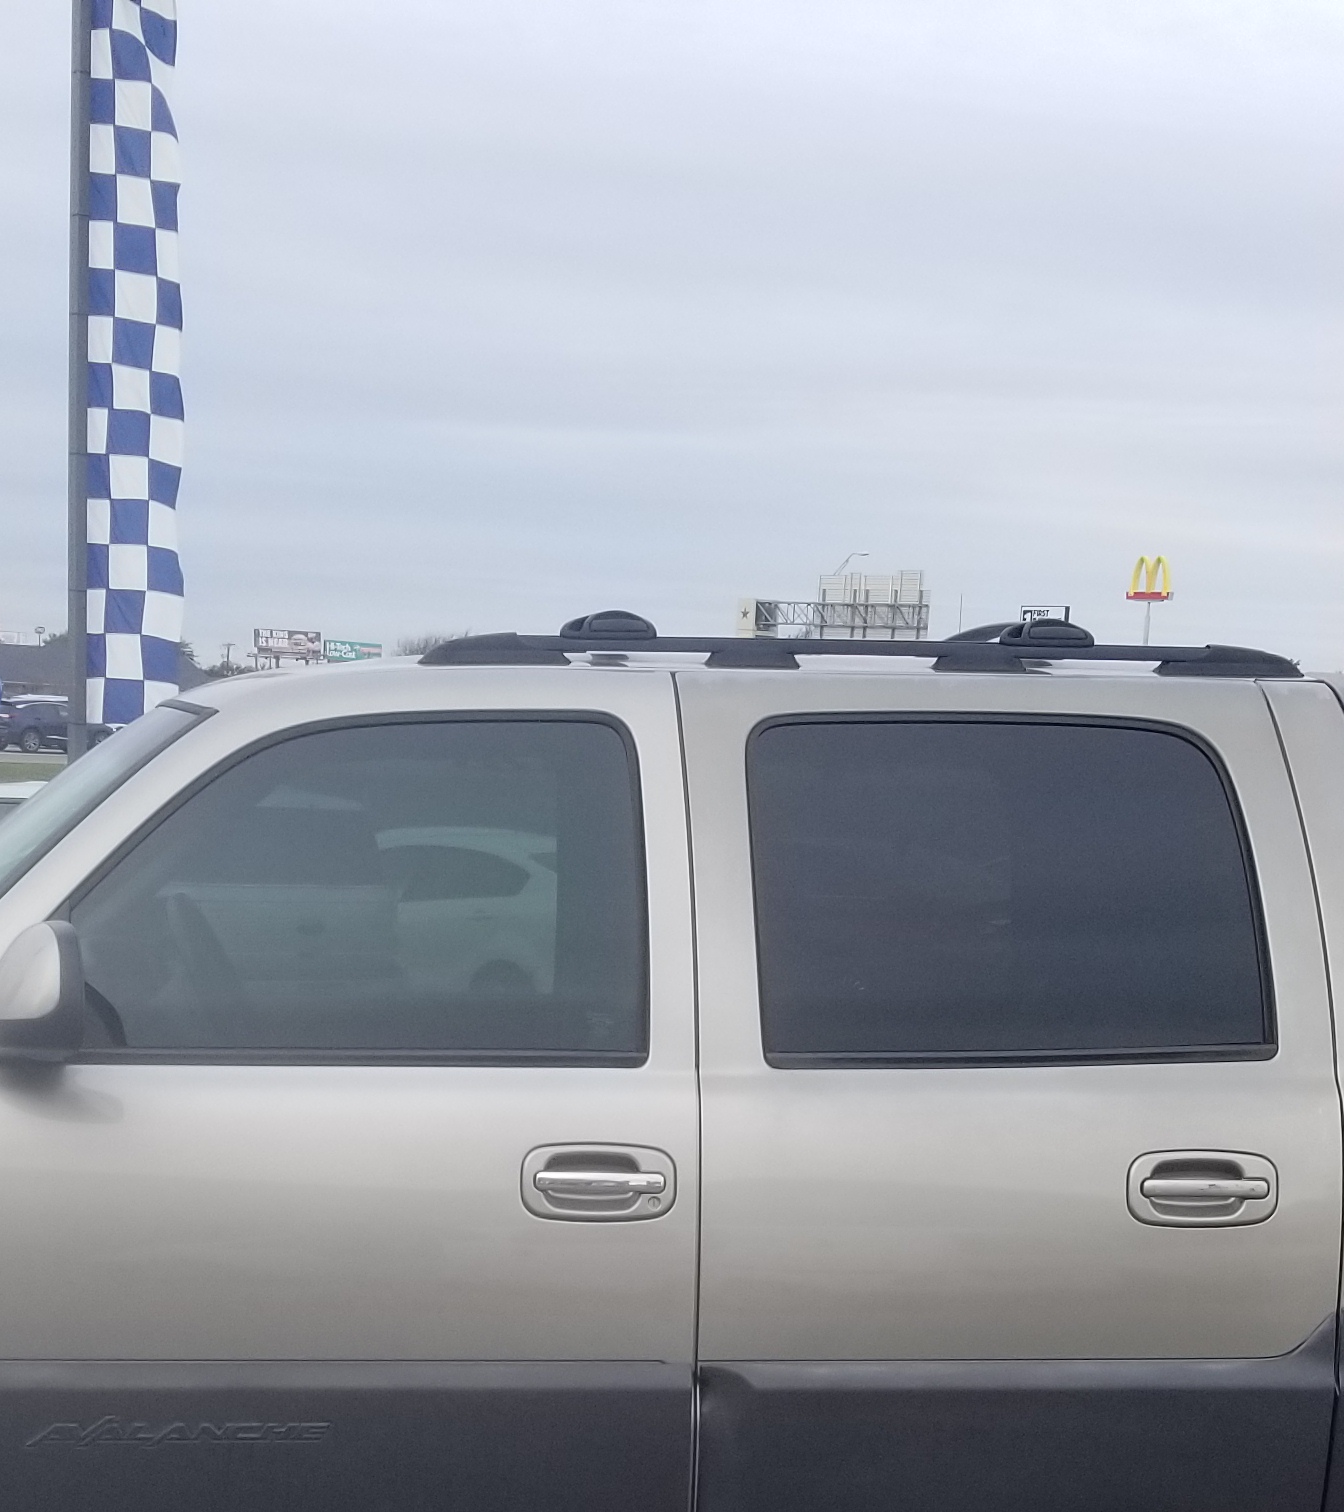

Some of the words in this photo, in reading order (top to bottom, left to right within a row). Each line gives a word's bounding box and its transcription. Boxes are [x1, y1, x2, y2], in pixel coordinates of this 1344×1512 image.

[1033, 609, 1049, 617] FIRST
[259, 637, 266, 646] IS
[25, 1415, 331, 1449] AVALANCHE
